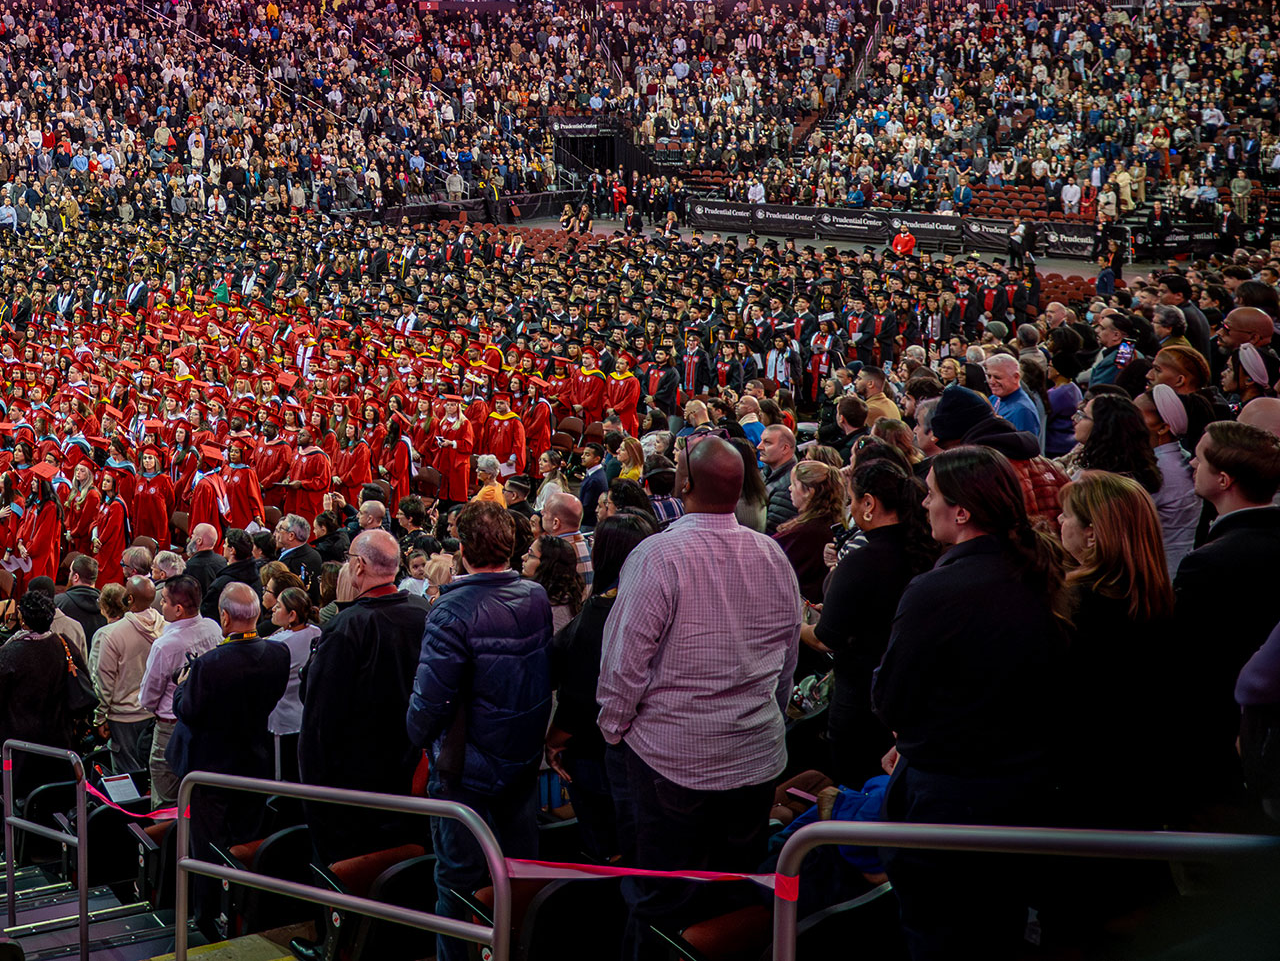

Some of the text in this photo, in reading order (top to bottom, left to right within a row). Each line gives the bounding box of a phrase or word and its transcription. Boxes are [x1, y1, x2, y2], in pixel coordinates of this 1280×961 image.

[426, 2, 431, 10] 5
[704, 207, 750, 217] Prudential Center
[765, 212, 794, 220] Prudential
[832, 215, 883, 226] Prudential Center
